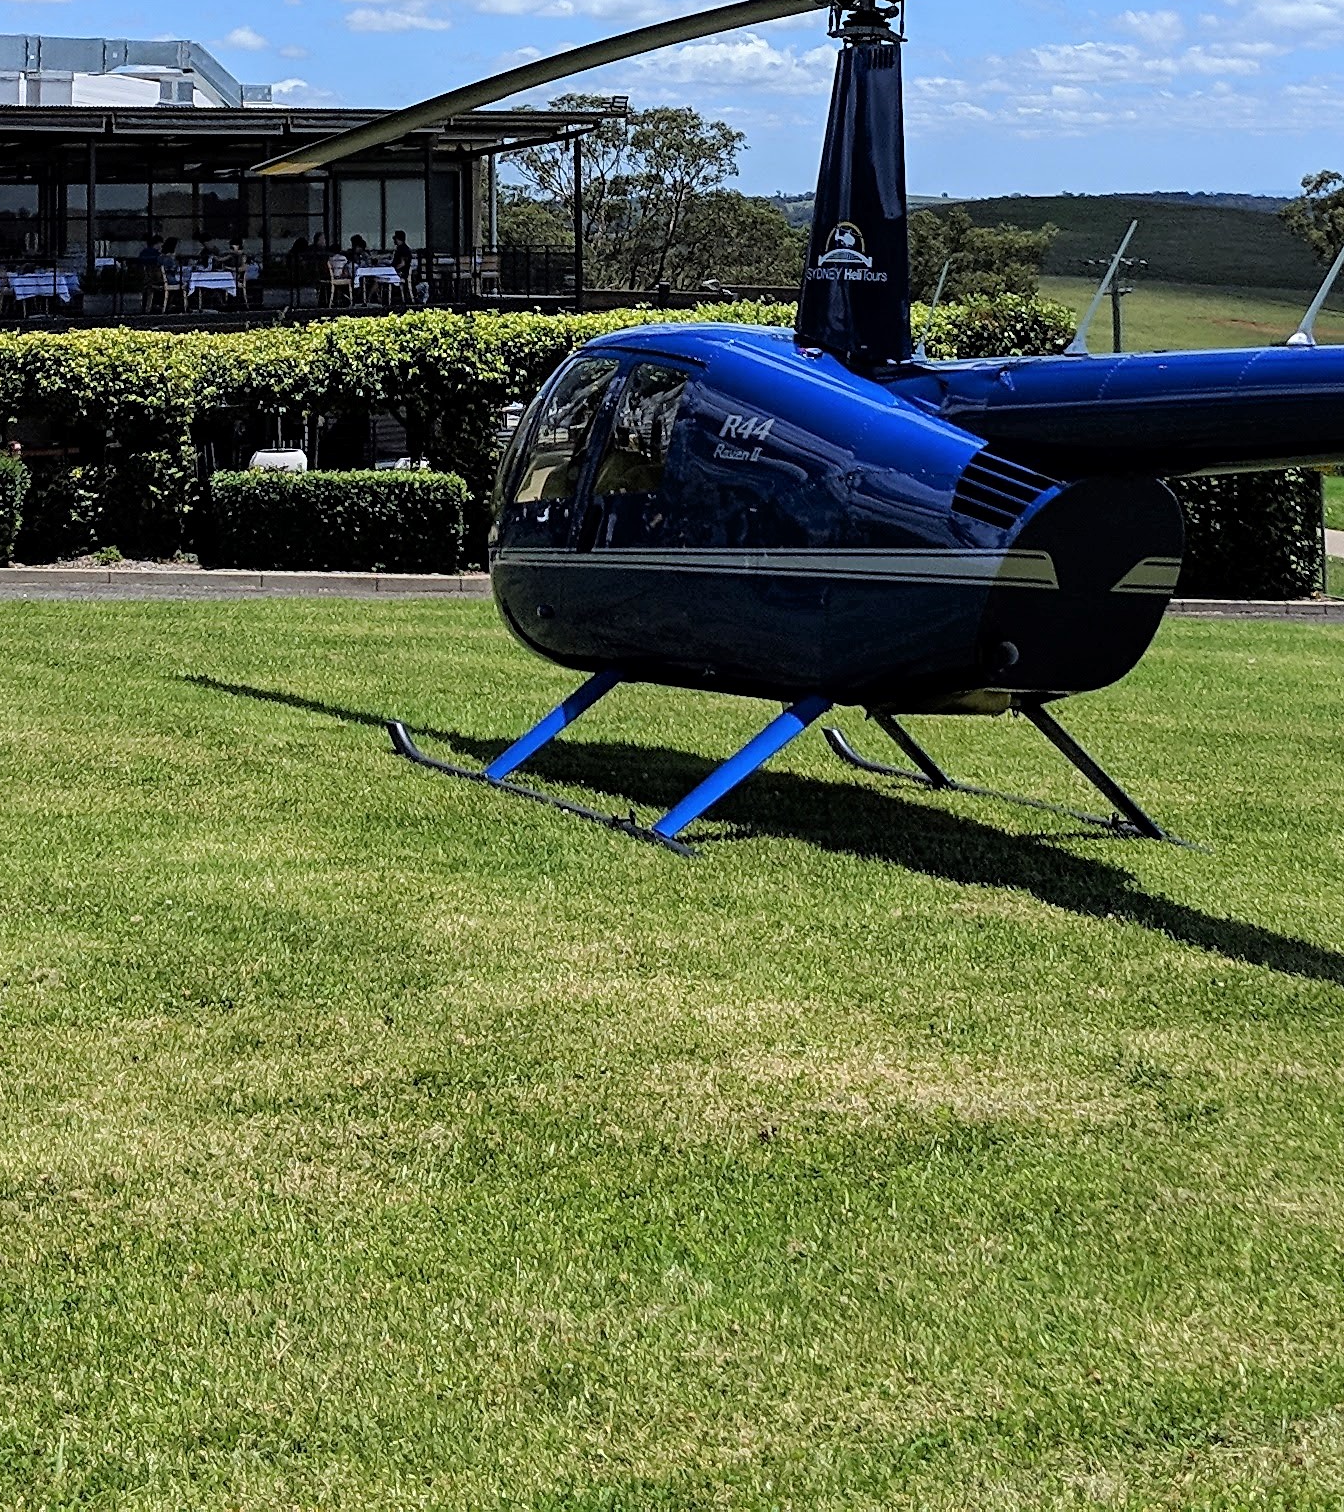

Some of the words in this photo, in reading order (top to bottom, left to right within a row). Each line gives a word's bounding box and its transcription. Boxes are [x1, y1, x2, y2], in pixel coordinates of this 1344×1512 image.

[806, 267, 843, 280] SYDNEY
[718, 414, 775, 441] R44
[713, 443, 750, 461] Raven
